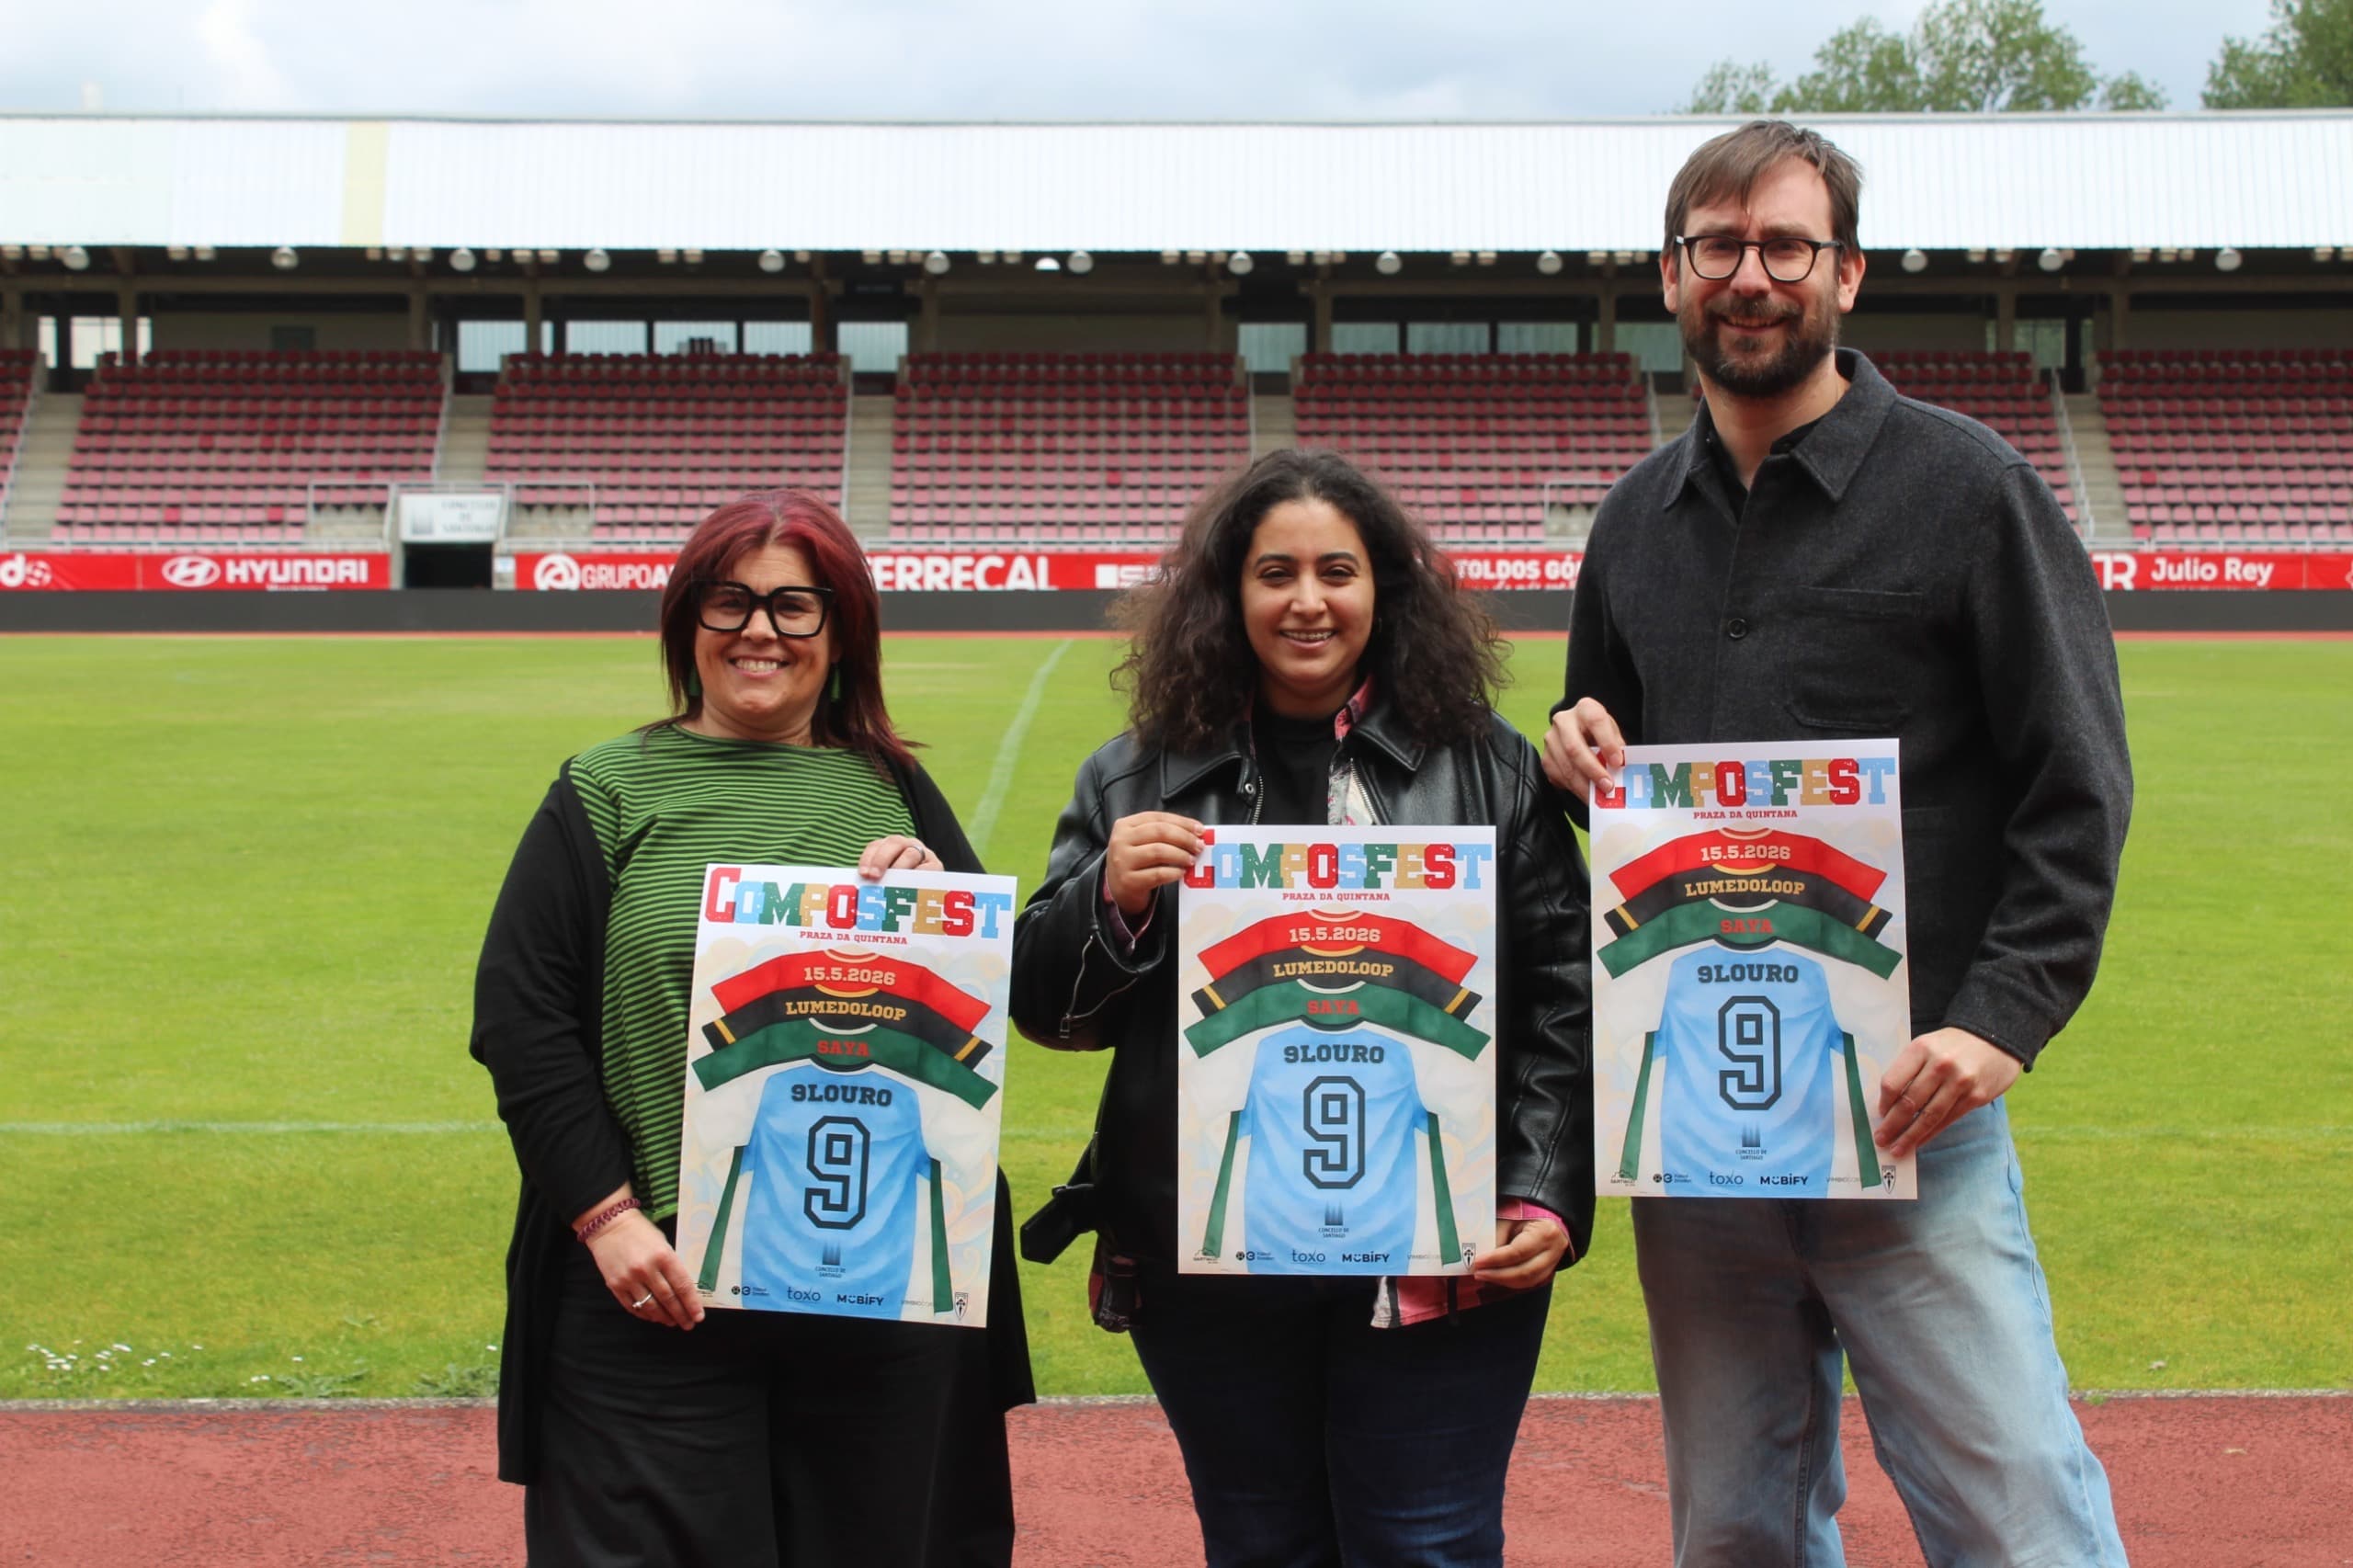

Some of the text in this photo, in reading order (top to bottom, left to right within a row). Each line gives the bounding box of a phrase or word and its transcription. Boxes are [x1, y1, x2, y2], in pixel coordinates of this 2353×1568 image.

[225, 559, 369, 584] HYUNDAI
[581, 563, 676, 589] GRUPOA
[866, 555, 1058, 591] ERRECAL
[1455, 559, 1540, 580] TOLDOS
[2151, 556, 2218, 582] Julio
[2224, 556, 2274, 587] Rey
[1693, 809, 1798, 820] PRAZA DA QUINTANA
[1700, 845, 1790, 861] 15.5.2026
[1282, 892, 1390, 902] PRAZA DA QUINTANA
[1685, 879, 1805, 897] LUMEDOLOOP
[705, 867, 1012, 939] COMPOSFEST
[1289, 927, 1381, 942] 15.5.2026
[1720, 918, 1773, 934] SAYA
[800, 931, 908, 945] PRAZA DA QUINTANA
[803, 967, 896, 985] 15.5.2026
[1273, 960, 1393, 977] LUMEDOLOOP
[1698, 964, 1799, 983] 9LOURO
[786, 1000, 906, 1020] LUMEDOLOOP
[1306, 1000, 1359, 1015] SAYA
[817, 1040, 870, 1056] SAYA
[1283, 1044, 1384, 1063] 9LOURO
[1718, 995, 1781, 1110] 9
[791, 1084, 892, 1107] 9LOURO
[1303, 1075, 1365, 1189] 9
[803, 1115, 870, 1230] 9
[1709, 1170, 1744, 1185] toxo
[1291, 1249, 1325, 1262] toxo
[787, 1286, 821, 1301] toxo
